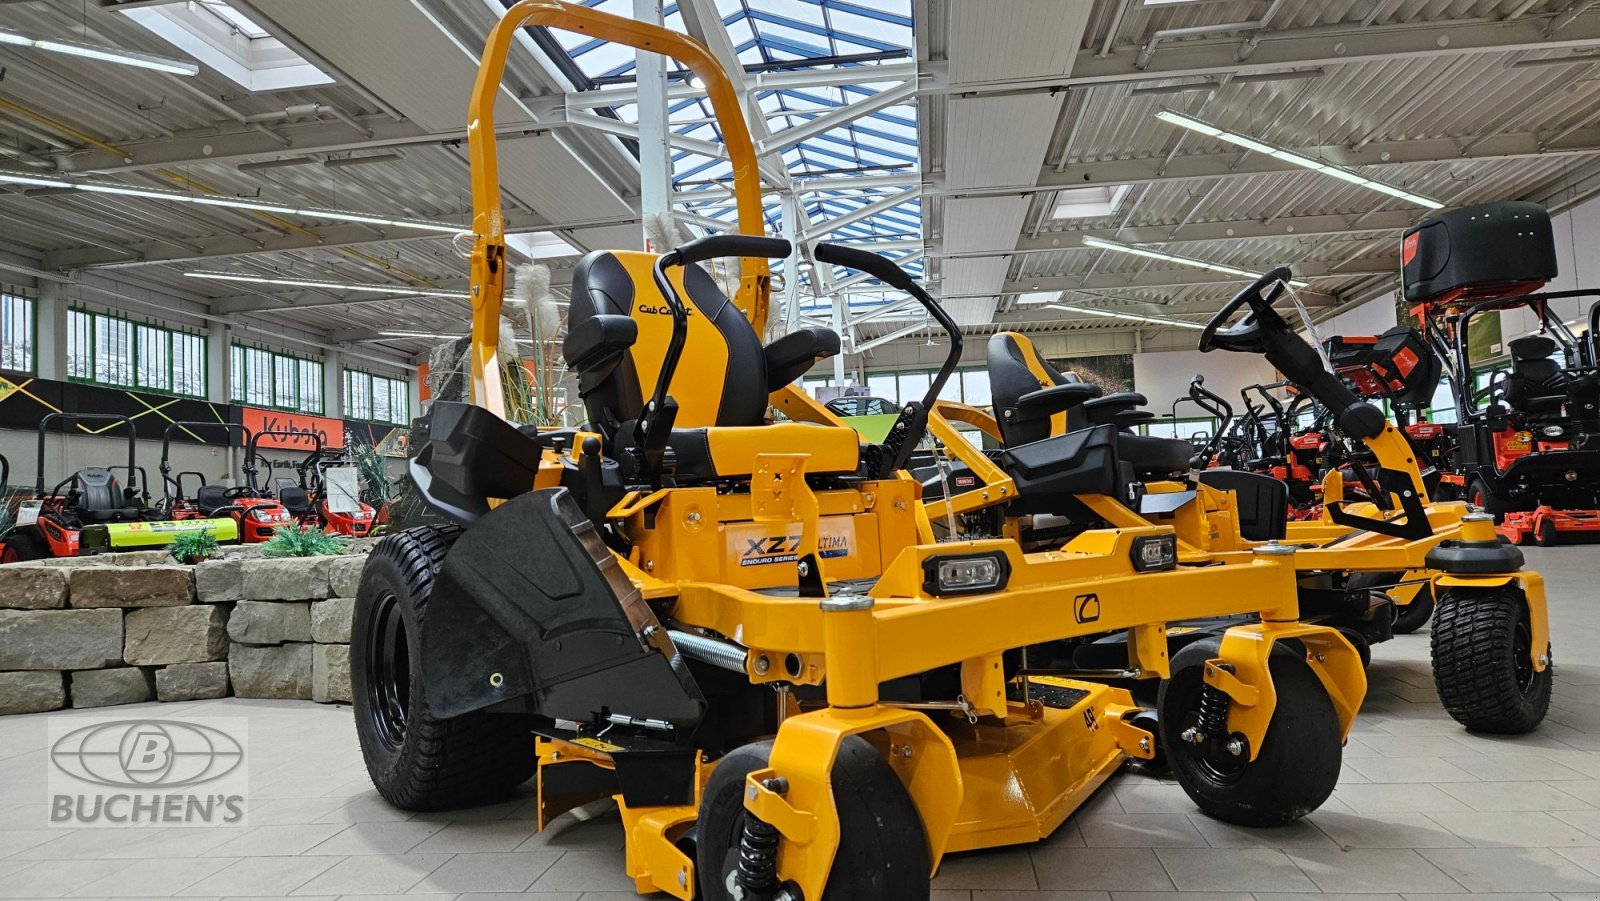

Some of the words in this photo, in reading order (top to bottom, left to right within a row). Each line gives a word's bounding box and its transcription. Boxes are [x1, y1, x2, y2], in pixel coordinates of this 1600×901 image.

[639, 304, 658, 314] Cub
[659, 306, 694, 316] Cat
[263, 416, 328, 446] Kubota
[743, 535, 801, 556] XZ7
[818, 535, 847, 549] LTIMA
[742, 557, 772, 566] ENDURO
